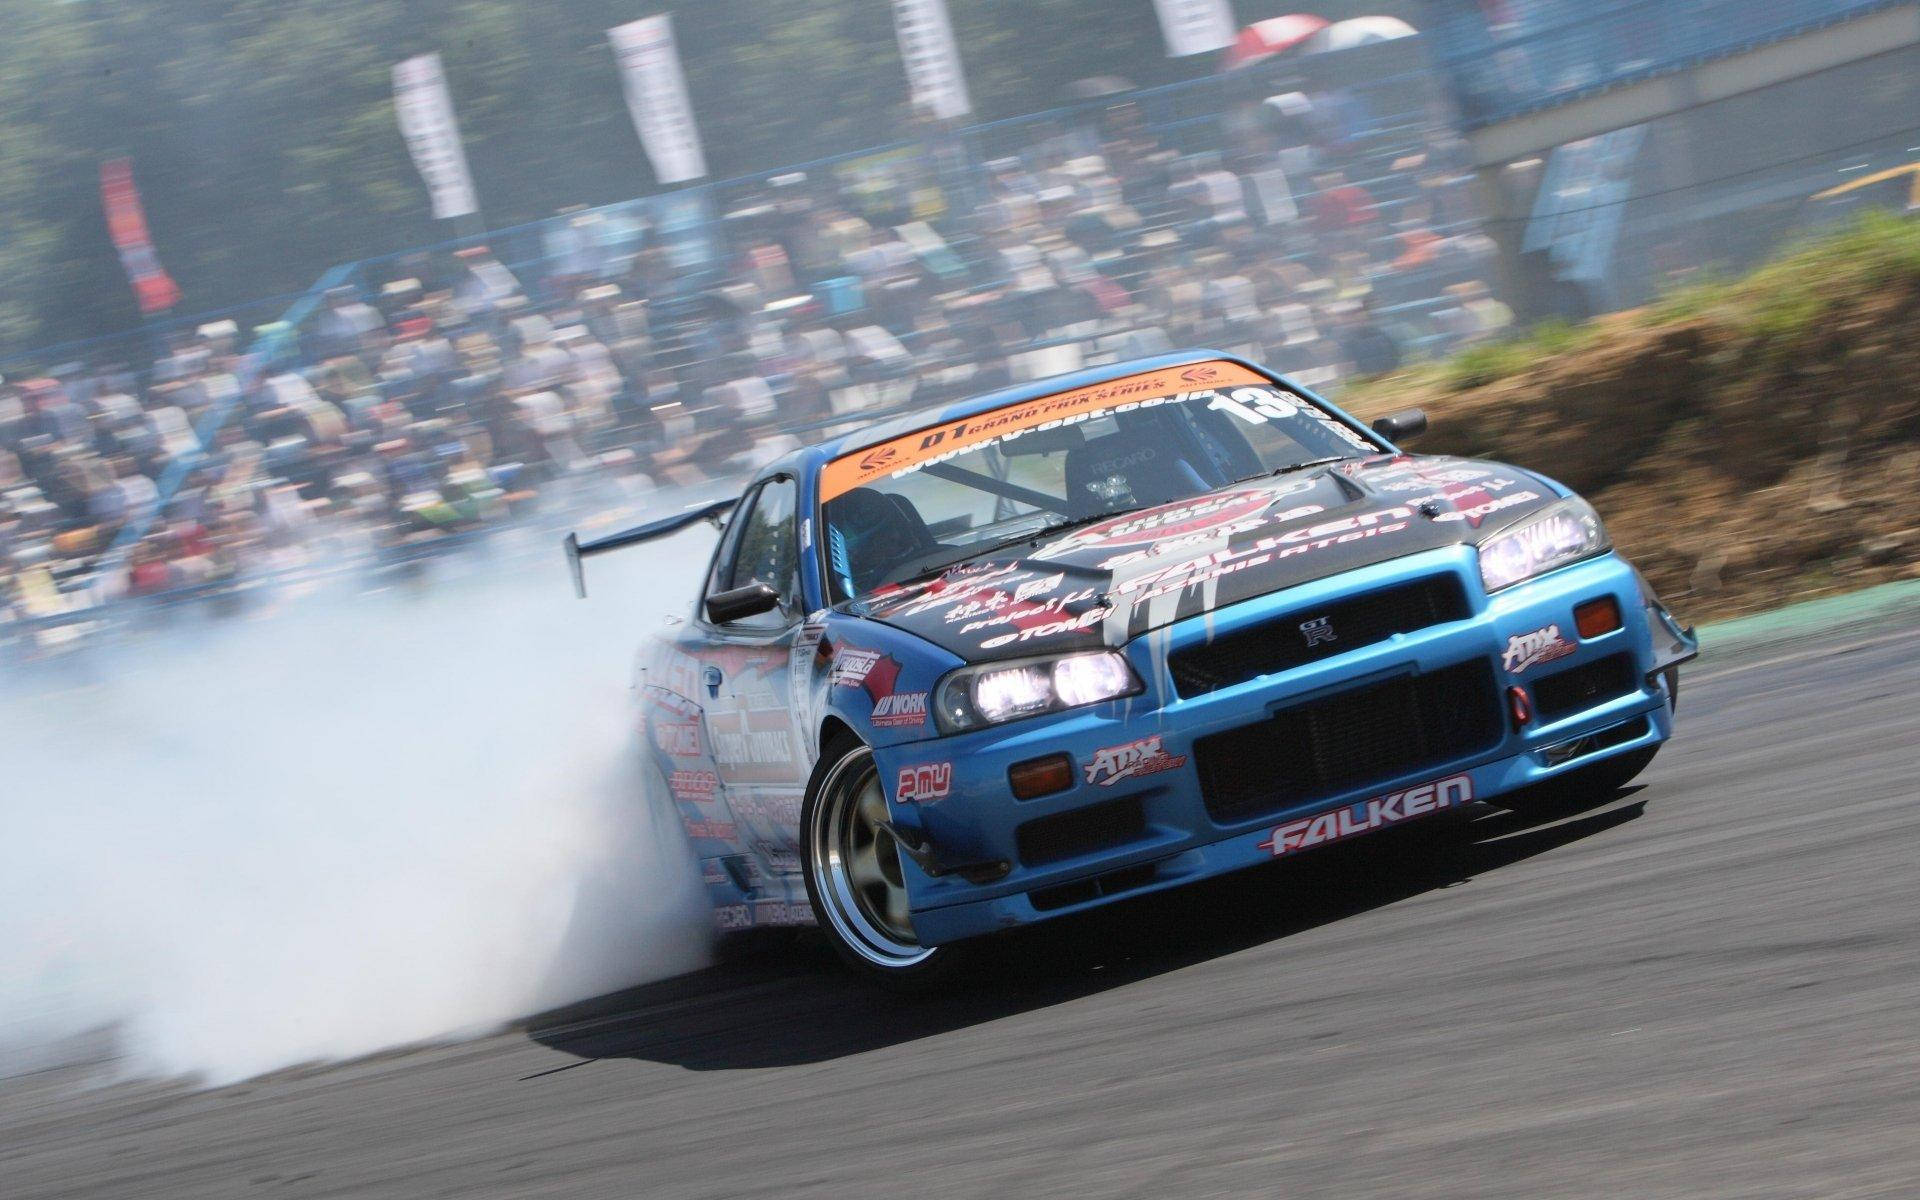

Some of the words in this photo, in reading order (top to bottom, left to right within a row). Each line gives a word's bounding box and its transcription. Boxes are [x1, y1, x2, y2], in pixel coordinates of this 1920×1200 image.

[919, 423, 967, 451] D1
[968, 409, 1038, 435] GRAND
[1043, 395, 1090, 414] PRIX
[1096, 381, 1166, 401] SERIES
[1207, 387, 1298, 425] 13
[1089, 448, 1156, 474] RECARO
[1108, 505, 1414, 595] FALKEN
[1020, 602, 1119, 641] TOMEI
[1299, 616, 1331, 631] GT
[1302, 625, 1338, 648] R
[890, 692, 928, 716] WORK
[1266, 776, 1473, 856] FALKEN
